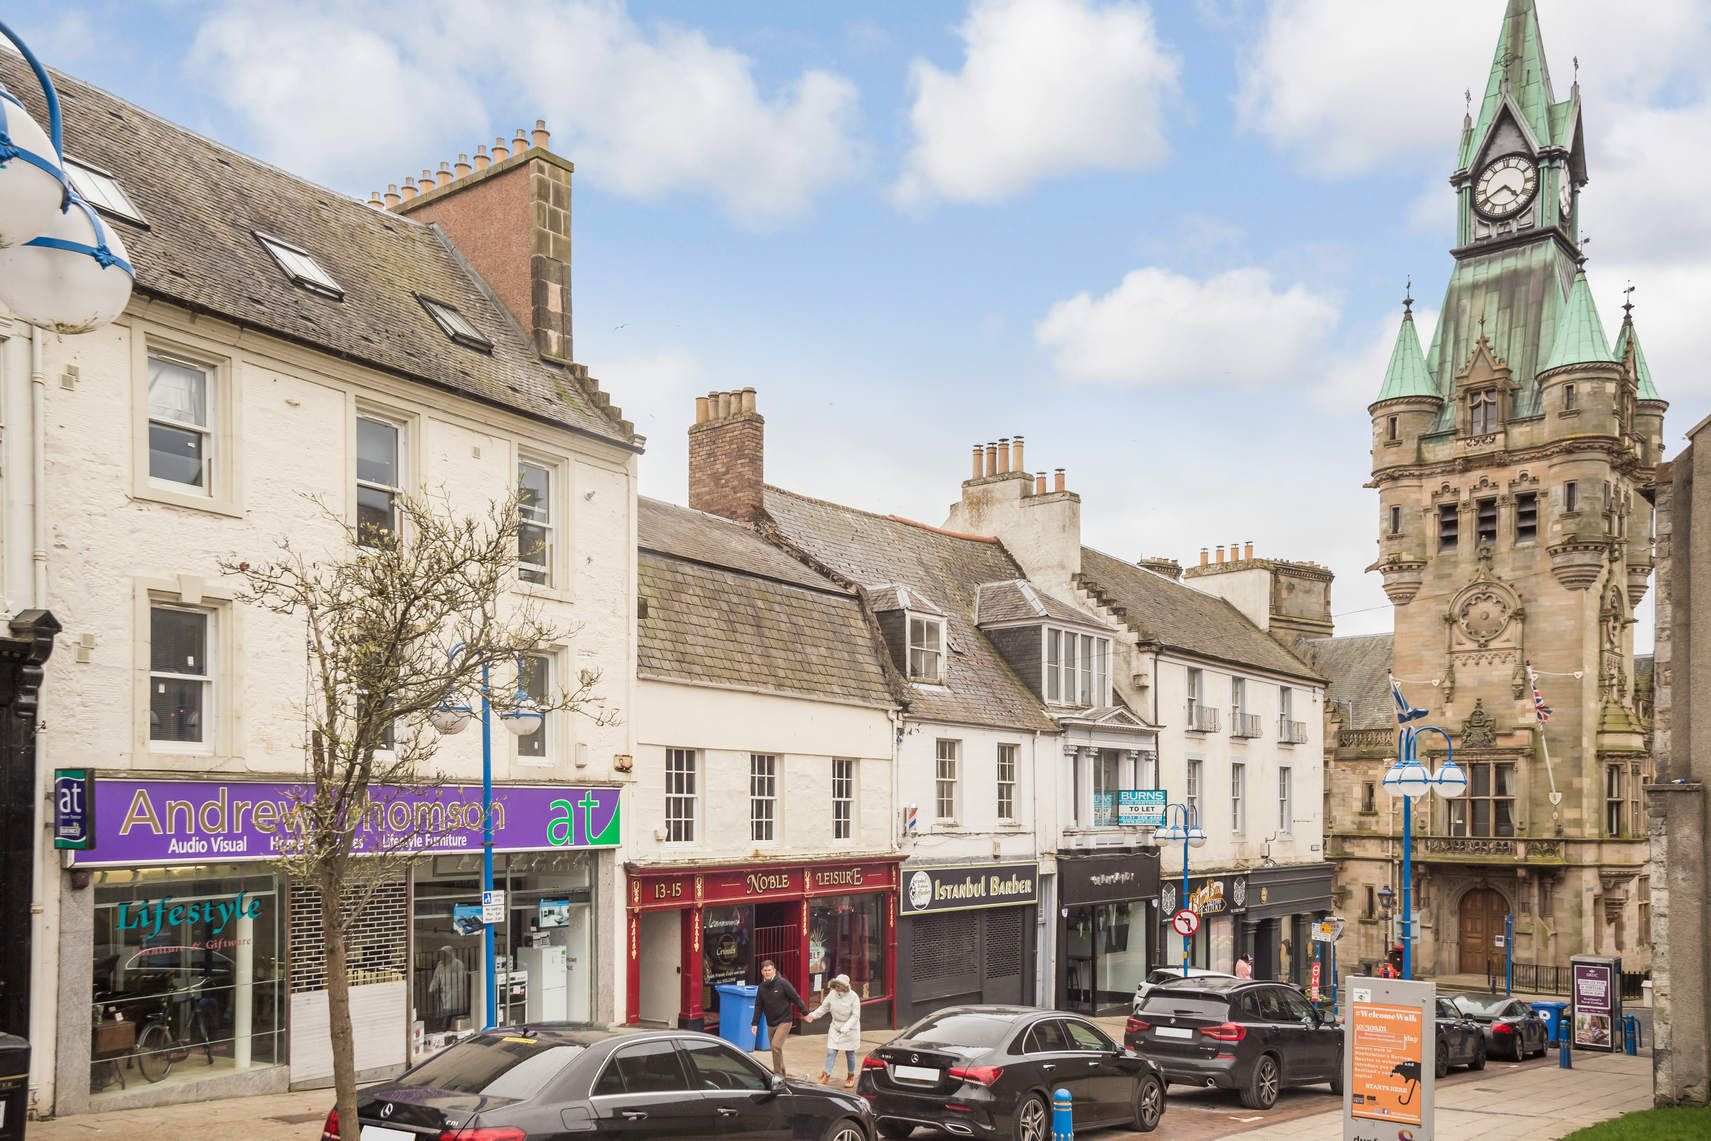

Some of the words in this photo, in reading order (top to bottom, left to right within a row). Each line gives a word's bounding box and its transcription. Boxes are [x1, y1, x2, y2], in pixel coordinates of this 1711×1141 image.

[60, 783, 81, 813] at
[1121, 791, 1164, 800] BURNS
[119, 787, 317, 836] Andrew
[326, 787, 505, 833] homson
[546, 790, 604, 846] at
[168, 837, 207, 854] Audio
[212, 836, 247, 852] Visual
[425, 833, 467, 848] Furniture
[655, 883, 682, 898] 13-15
[747, 873, 789, 894] NOBLE
[815, 868, 863, 886] LEISURE
[116, 890, 263, 940] Lifestyle
